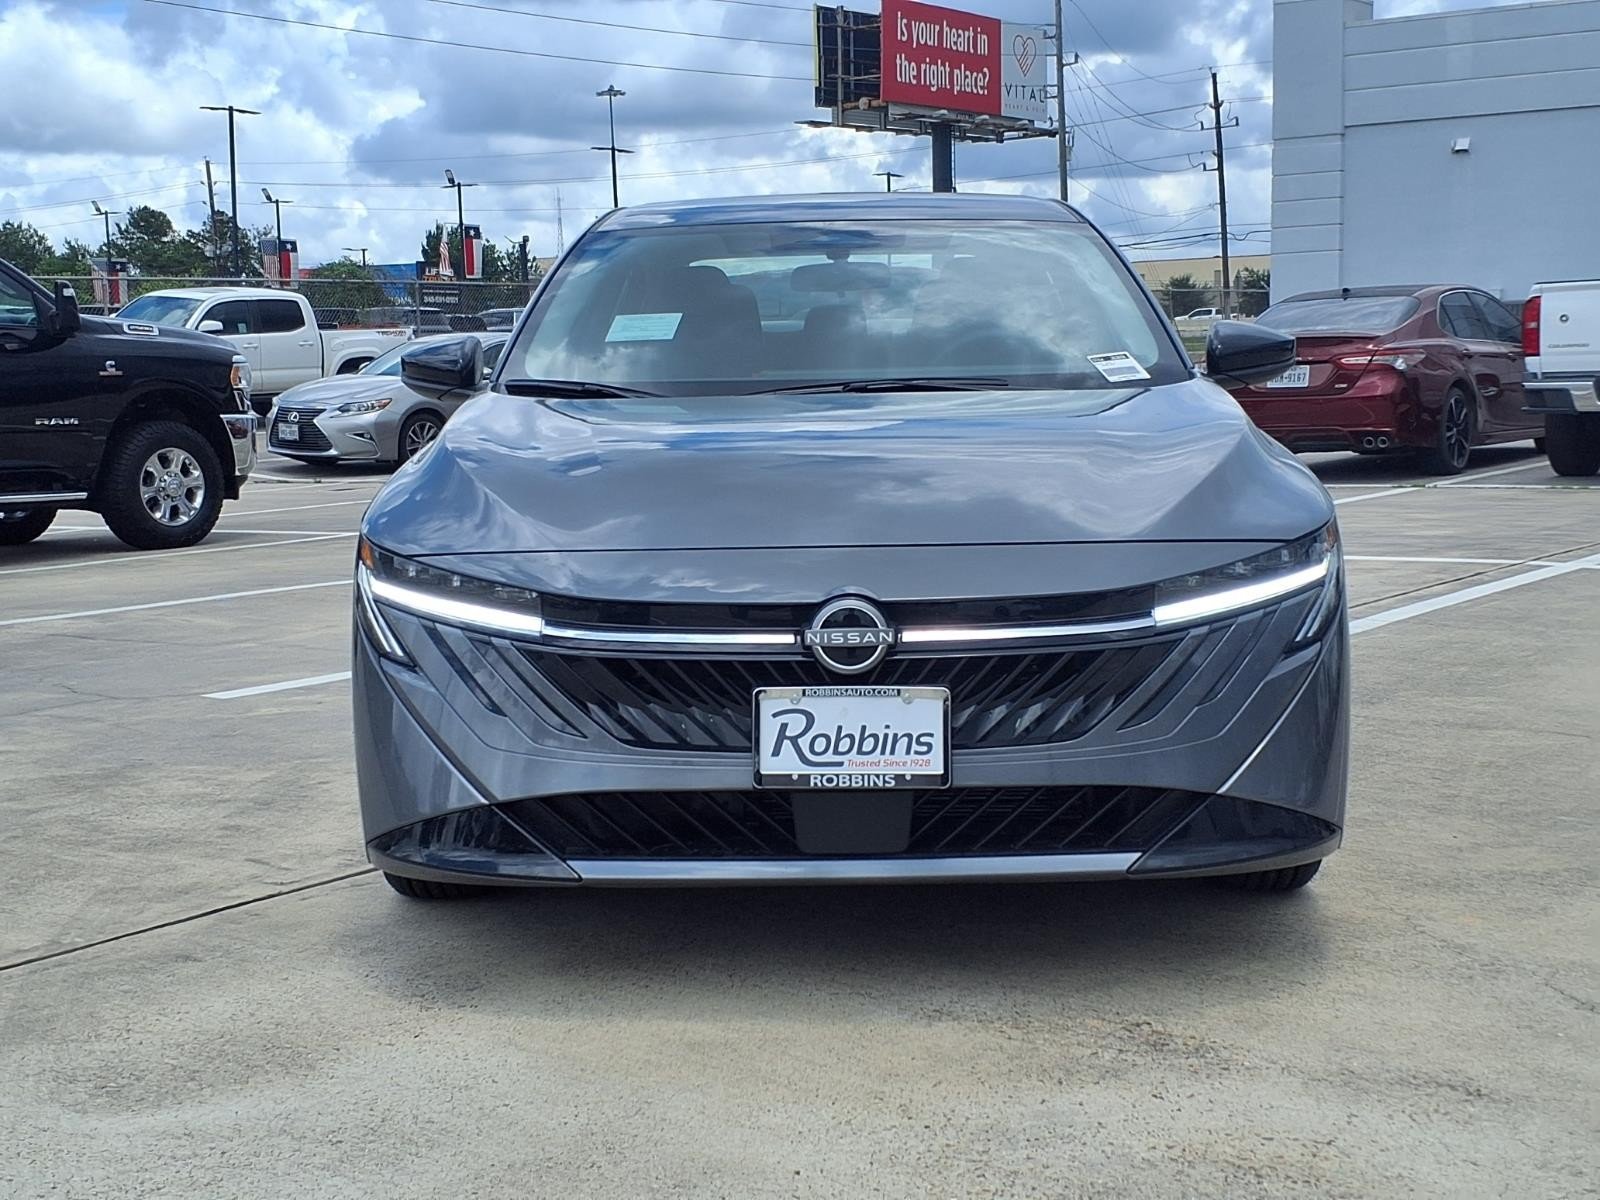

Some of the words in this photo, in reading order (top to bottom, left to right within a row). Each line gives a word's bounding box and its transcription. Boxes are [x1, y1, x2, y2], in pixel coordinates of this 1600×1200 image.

[897, 11, 908, 42] Is
[911, 20, 940, 48] your
[943, 20, 974, 54] heart
[977, 27, 988, 56] in
[896, 53, 917, 84] the
[920, 57, 950, 91] right
[953, 63, 990, 95] place?
[1004, 82, 1045, 103] VITAL
[35, 417, 79, 425] RAM
[806, 631, 894, 644] NISSAN
[805, 688, 898, 697] ROBBINSAUTO.COM
[770, 708, 935, 768] Robbins
[847, 758, 881, 767] Trusted
[882, 758, 907, 767] Since
[910, 758, 931, 767] 1928
[809, 774, 896, 787] ROBBINS
